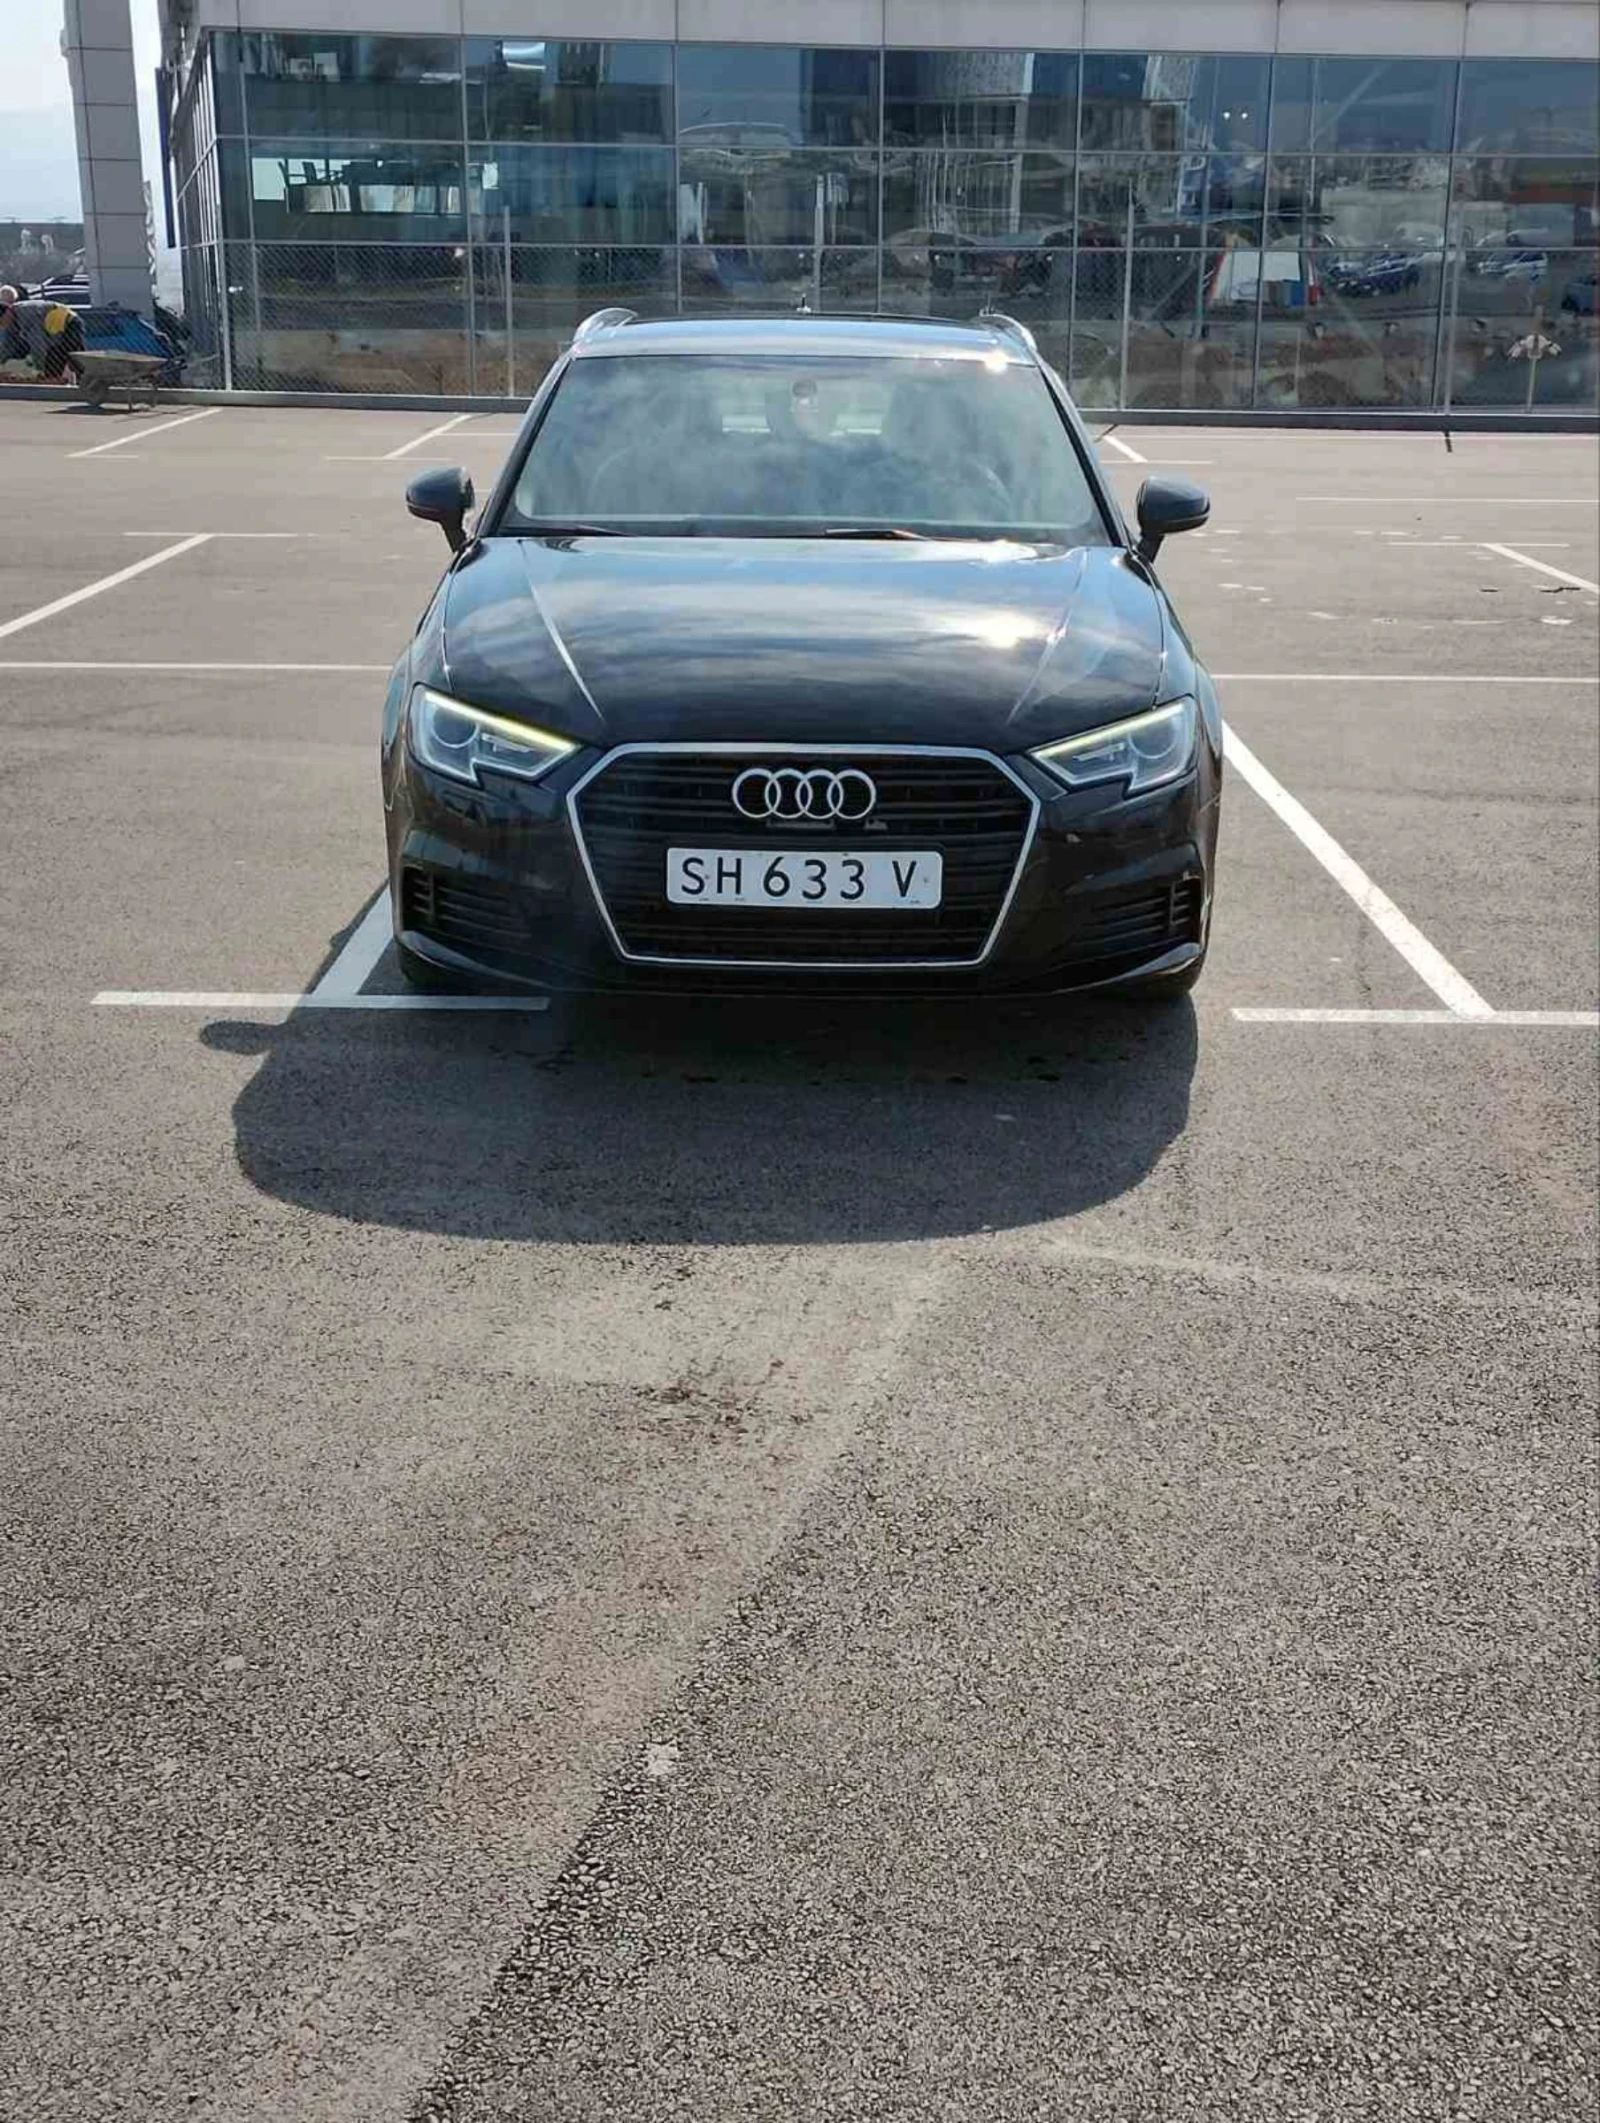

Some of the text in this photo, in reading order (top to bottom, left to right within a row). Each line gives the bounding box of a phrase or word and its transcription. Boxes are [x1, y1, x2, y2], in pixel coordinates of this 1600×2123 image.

[681, 856, 917, 900] SH 633 V
